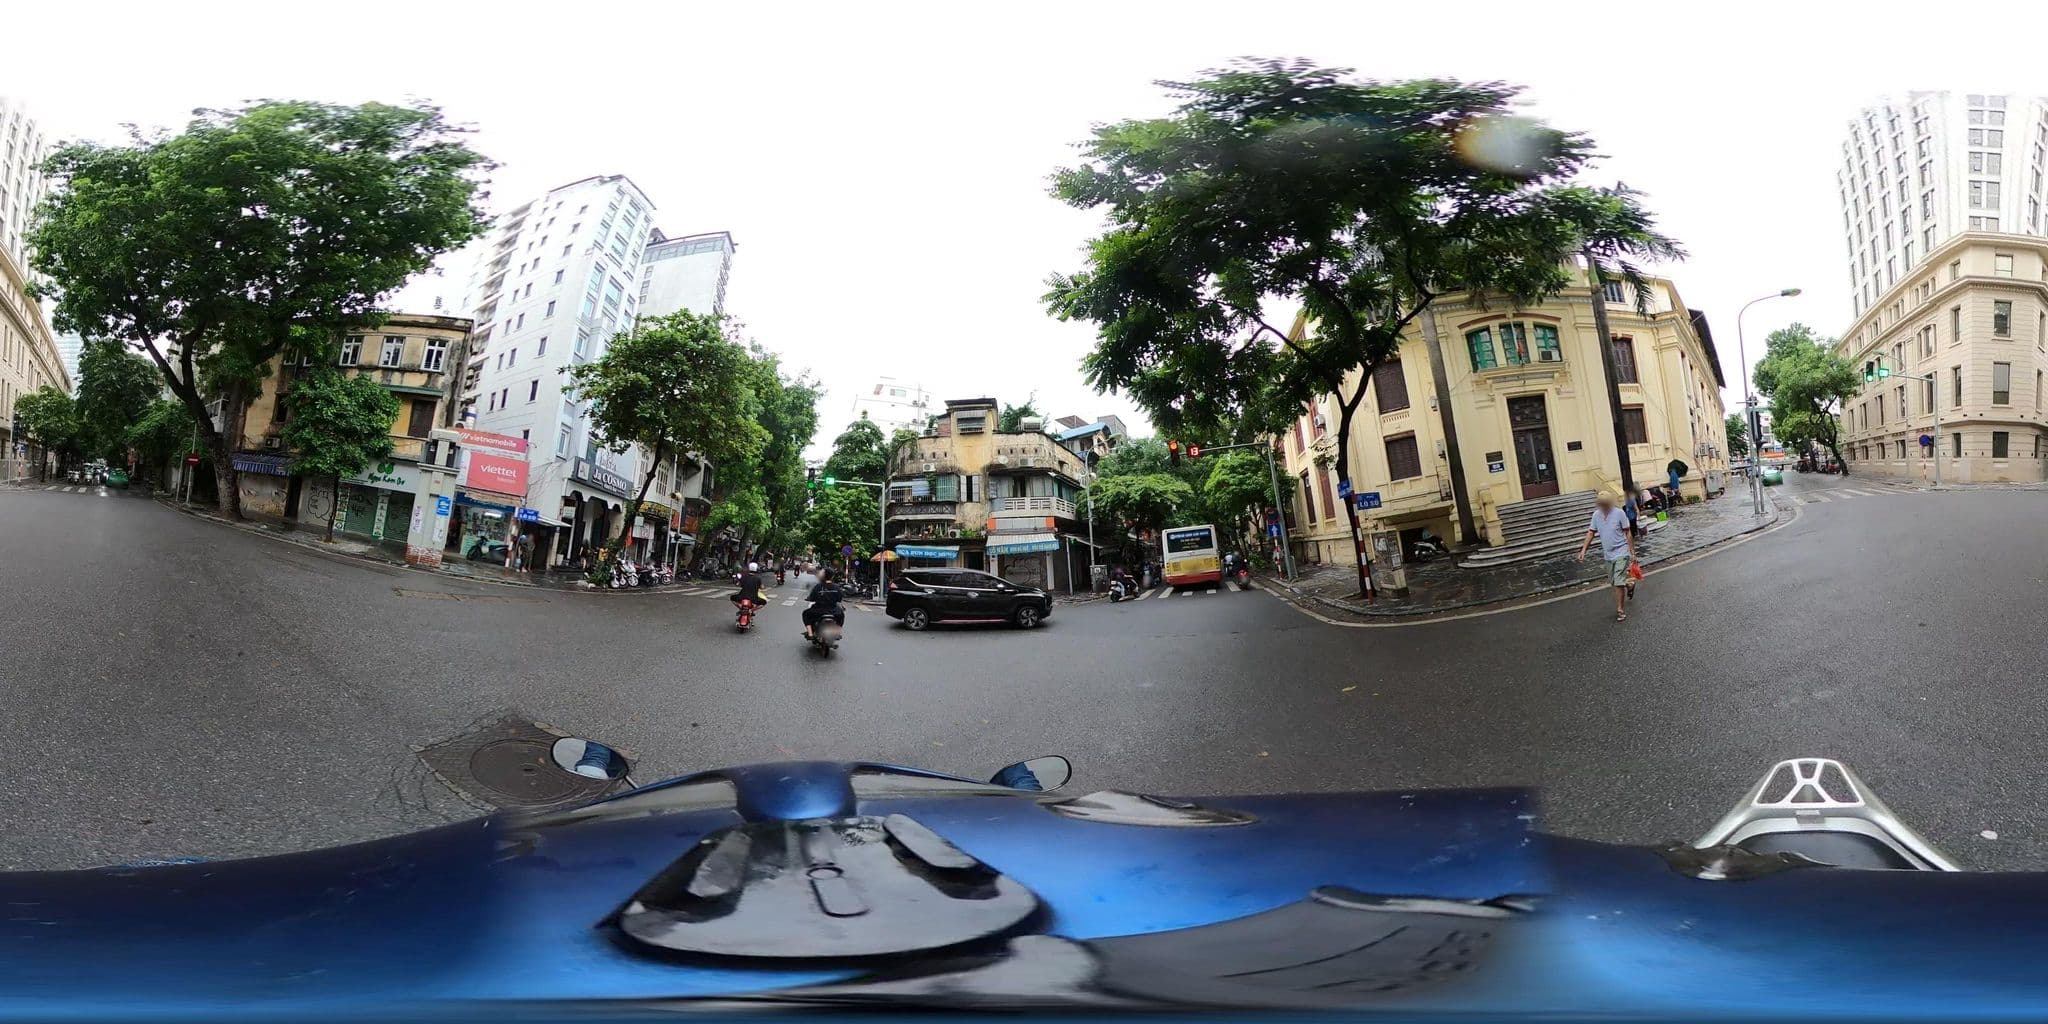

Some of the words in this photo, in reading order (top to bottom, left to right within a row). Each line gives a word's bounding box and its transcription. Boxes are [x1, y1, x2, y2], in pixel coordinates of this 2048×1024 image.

[470, 433, 517, 448] vietnamobile
[1190, 447, 1199, 456] 13
[480, 464, 517, 478] viettel
[602, 472, 627, 490] COSMO
